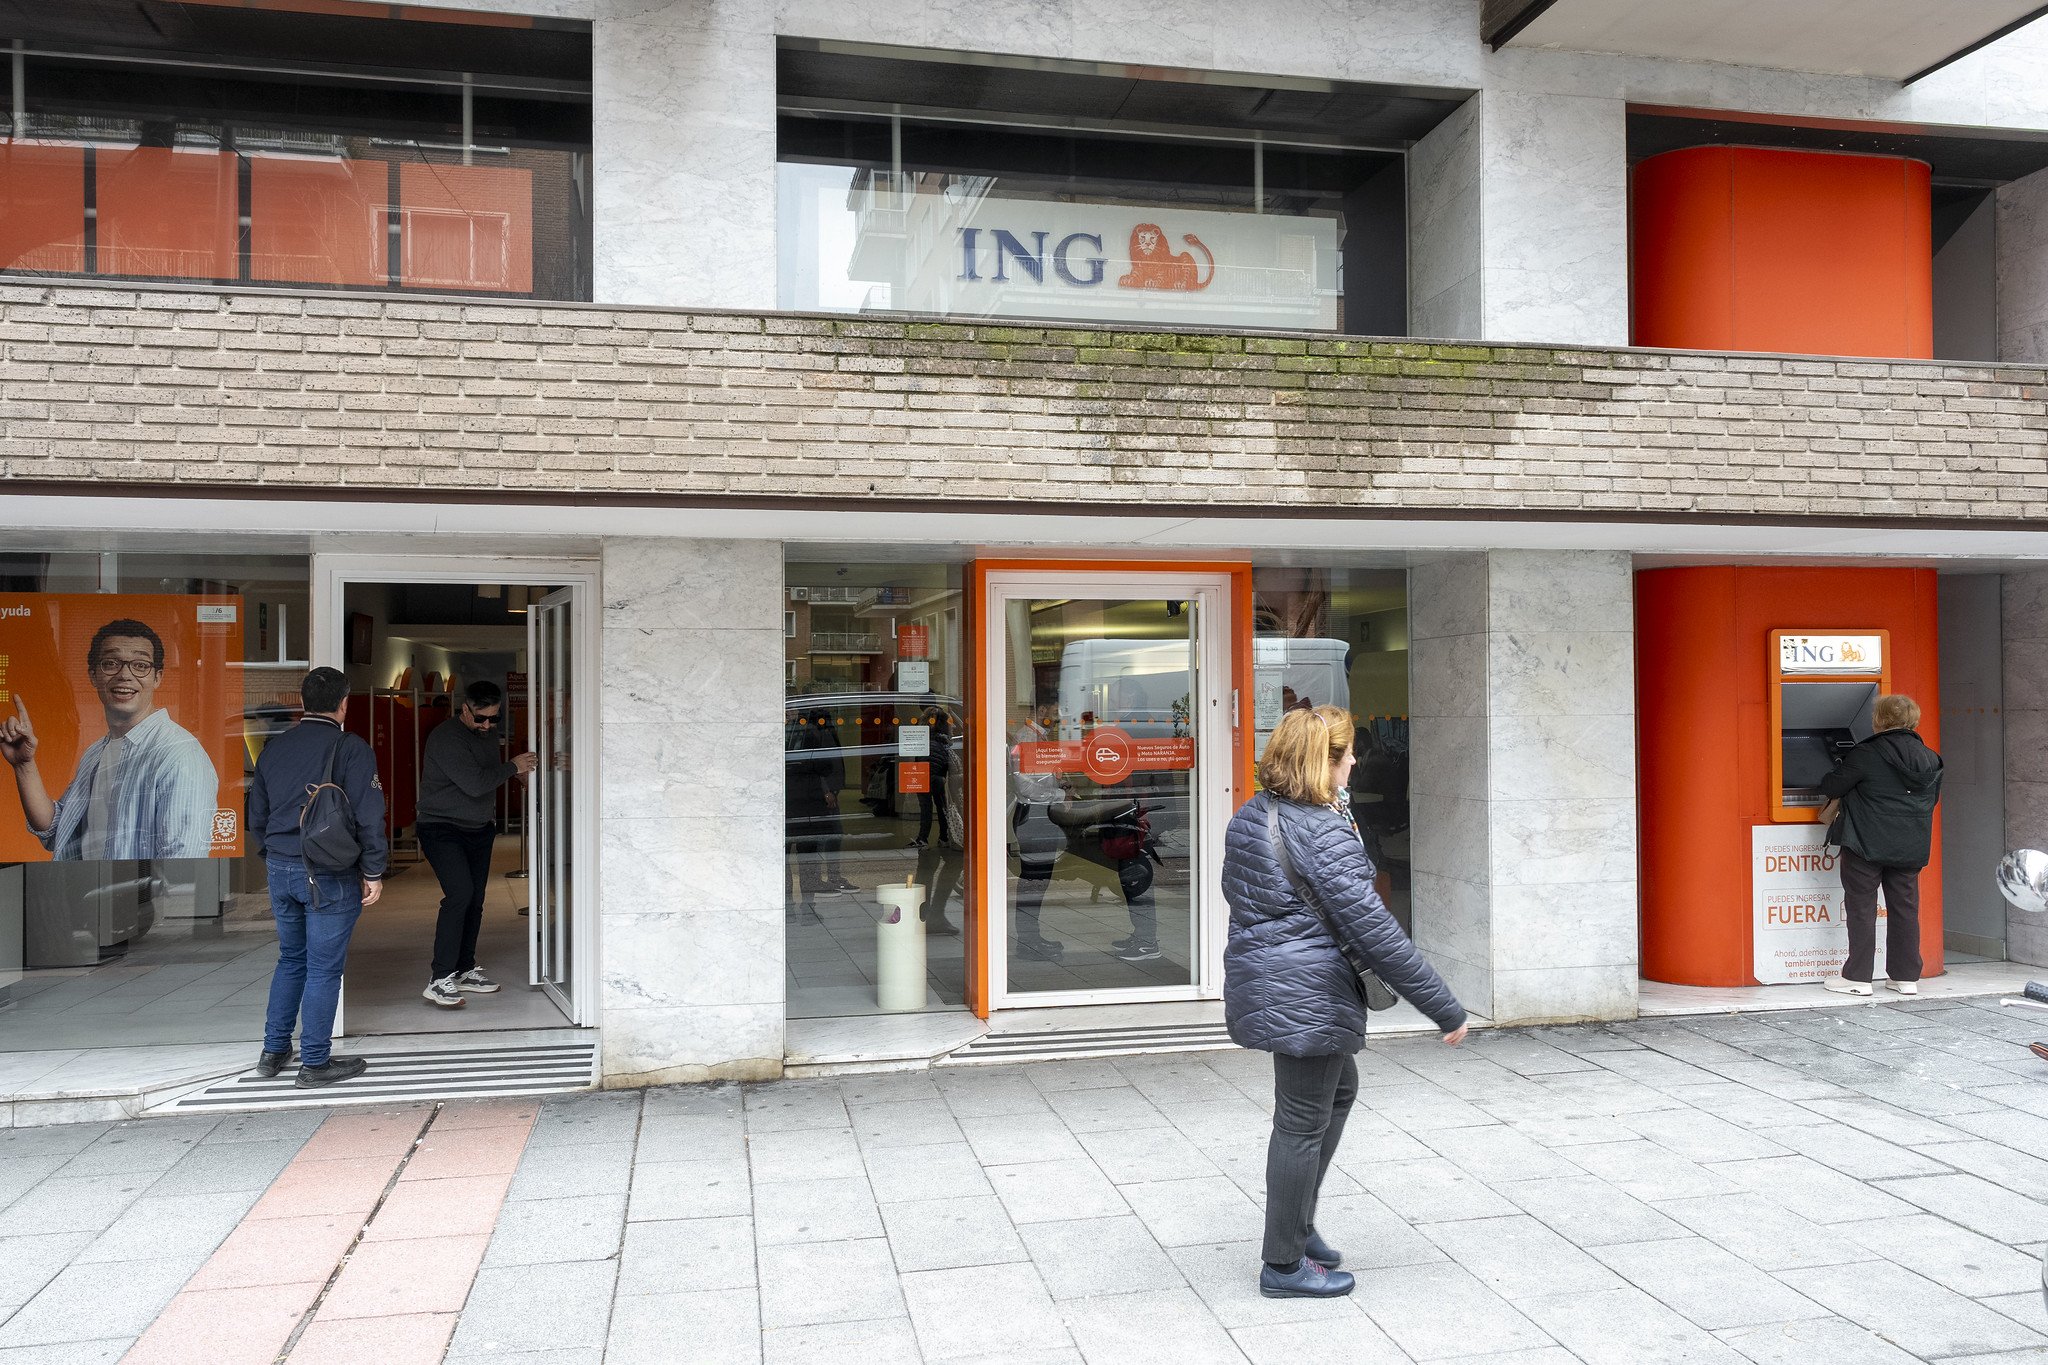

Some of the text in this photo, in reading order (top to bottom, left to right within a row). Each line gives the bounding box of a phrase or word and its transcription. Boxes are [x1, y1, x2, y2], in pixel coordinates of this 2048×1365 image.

[957, 227, 1108, 285] ING
[0, 604, 31, 620] yuda
[1793, 645, 1834, 662] ING
[1764, 844, 1824, 853] PUEDES INGRESAR
[1765, 854, 1835, 873] DENTRO
[1767, 893, 1831, 903] PUEDES INGRESAR
[1767, 904, 1831, 924] FUERA
[1828, 947, 1838, 956] de
[1784, 959, 1817, 968] también
[1816, 958, 1843, 968] puedes
[1816, 968, 1839, 979] cajero
